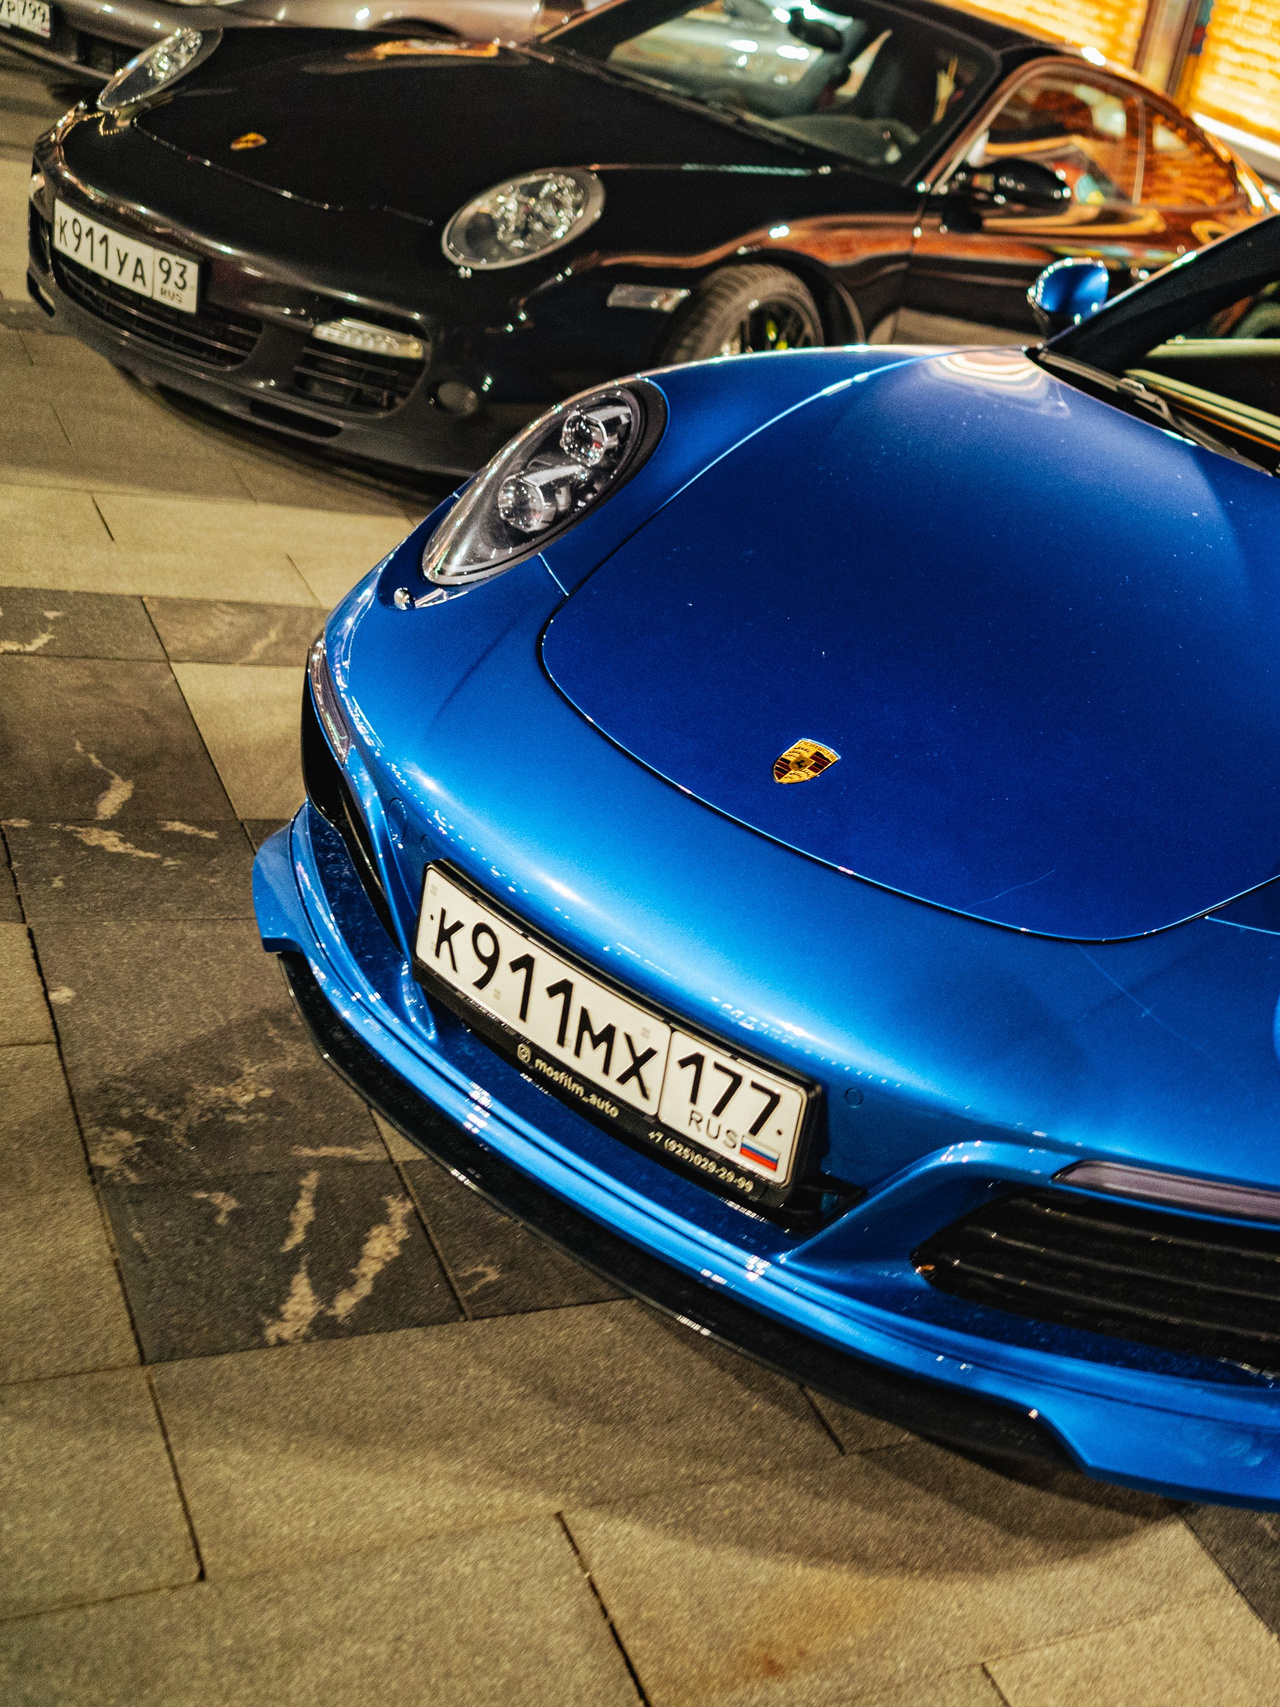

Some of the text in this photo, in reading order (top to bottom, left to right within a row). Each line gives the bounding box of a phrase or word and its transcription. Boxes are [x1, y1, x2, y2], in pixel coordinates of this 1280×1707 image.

[158, 256, 188, 290] 93
[160, 287, 184, 303] RUS
[533, 1058, 619, 1118] mosfilm_auto
[677, 1051, 783, 1137] 177
[688, 1109, 738, 1149] RUS
